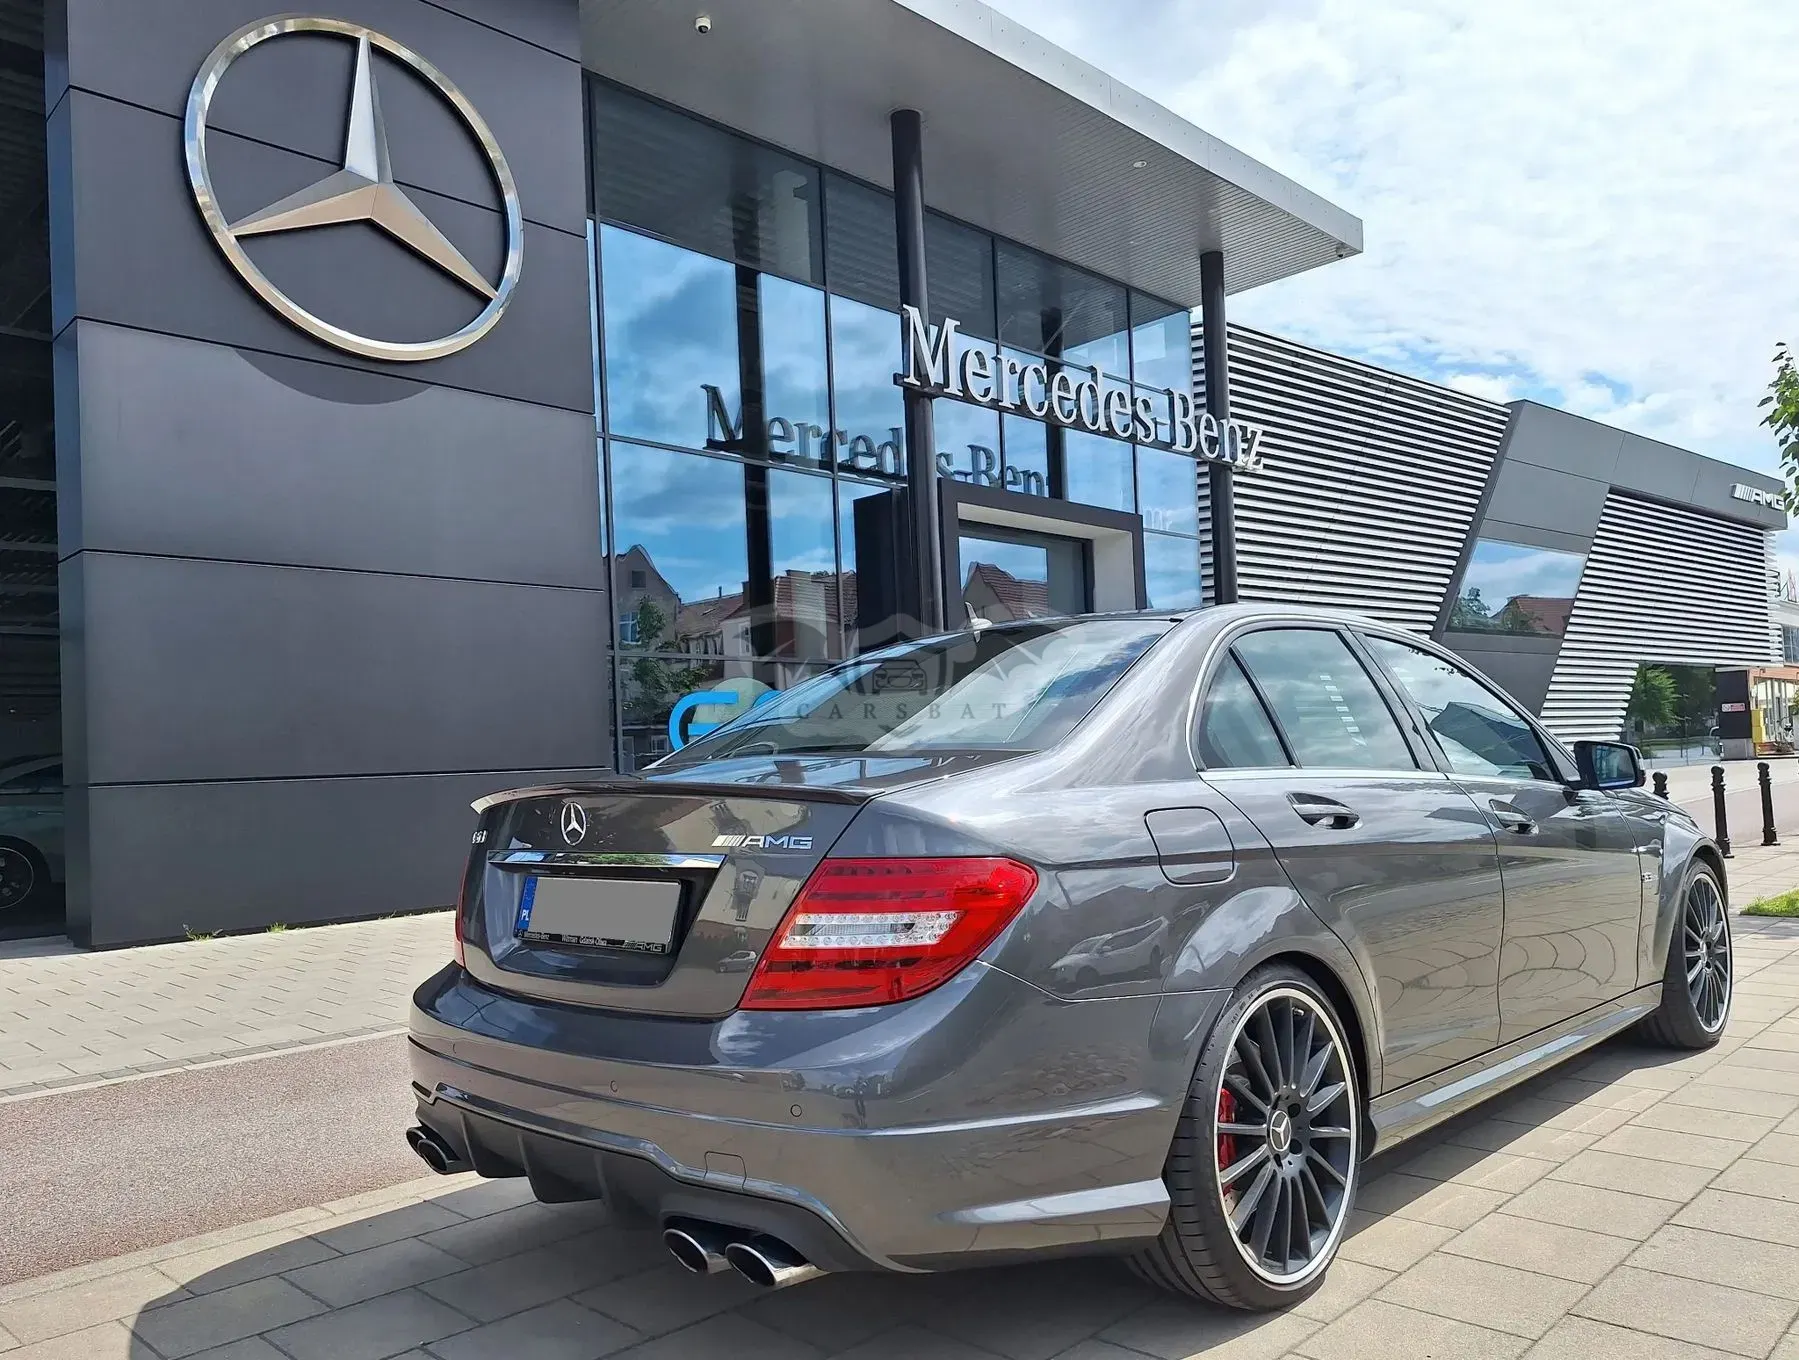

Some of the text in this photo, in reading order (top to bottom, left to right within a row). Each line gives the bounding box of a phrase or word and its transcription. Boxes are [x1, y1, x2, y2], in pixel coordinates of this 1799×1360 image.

[902, 304, 1264, 471] Mercedes-Benz
[1750, 488, 1785, 511] AMG
[742, 835, 813, 850] AMG
[521, 909, 530, 921] PL
